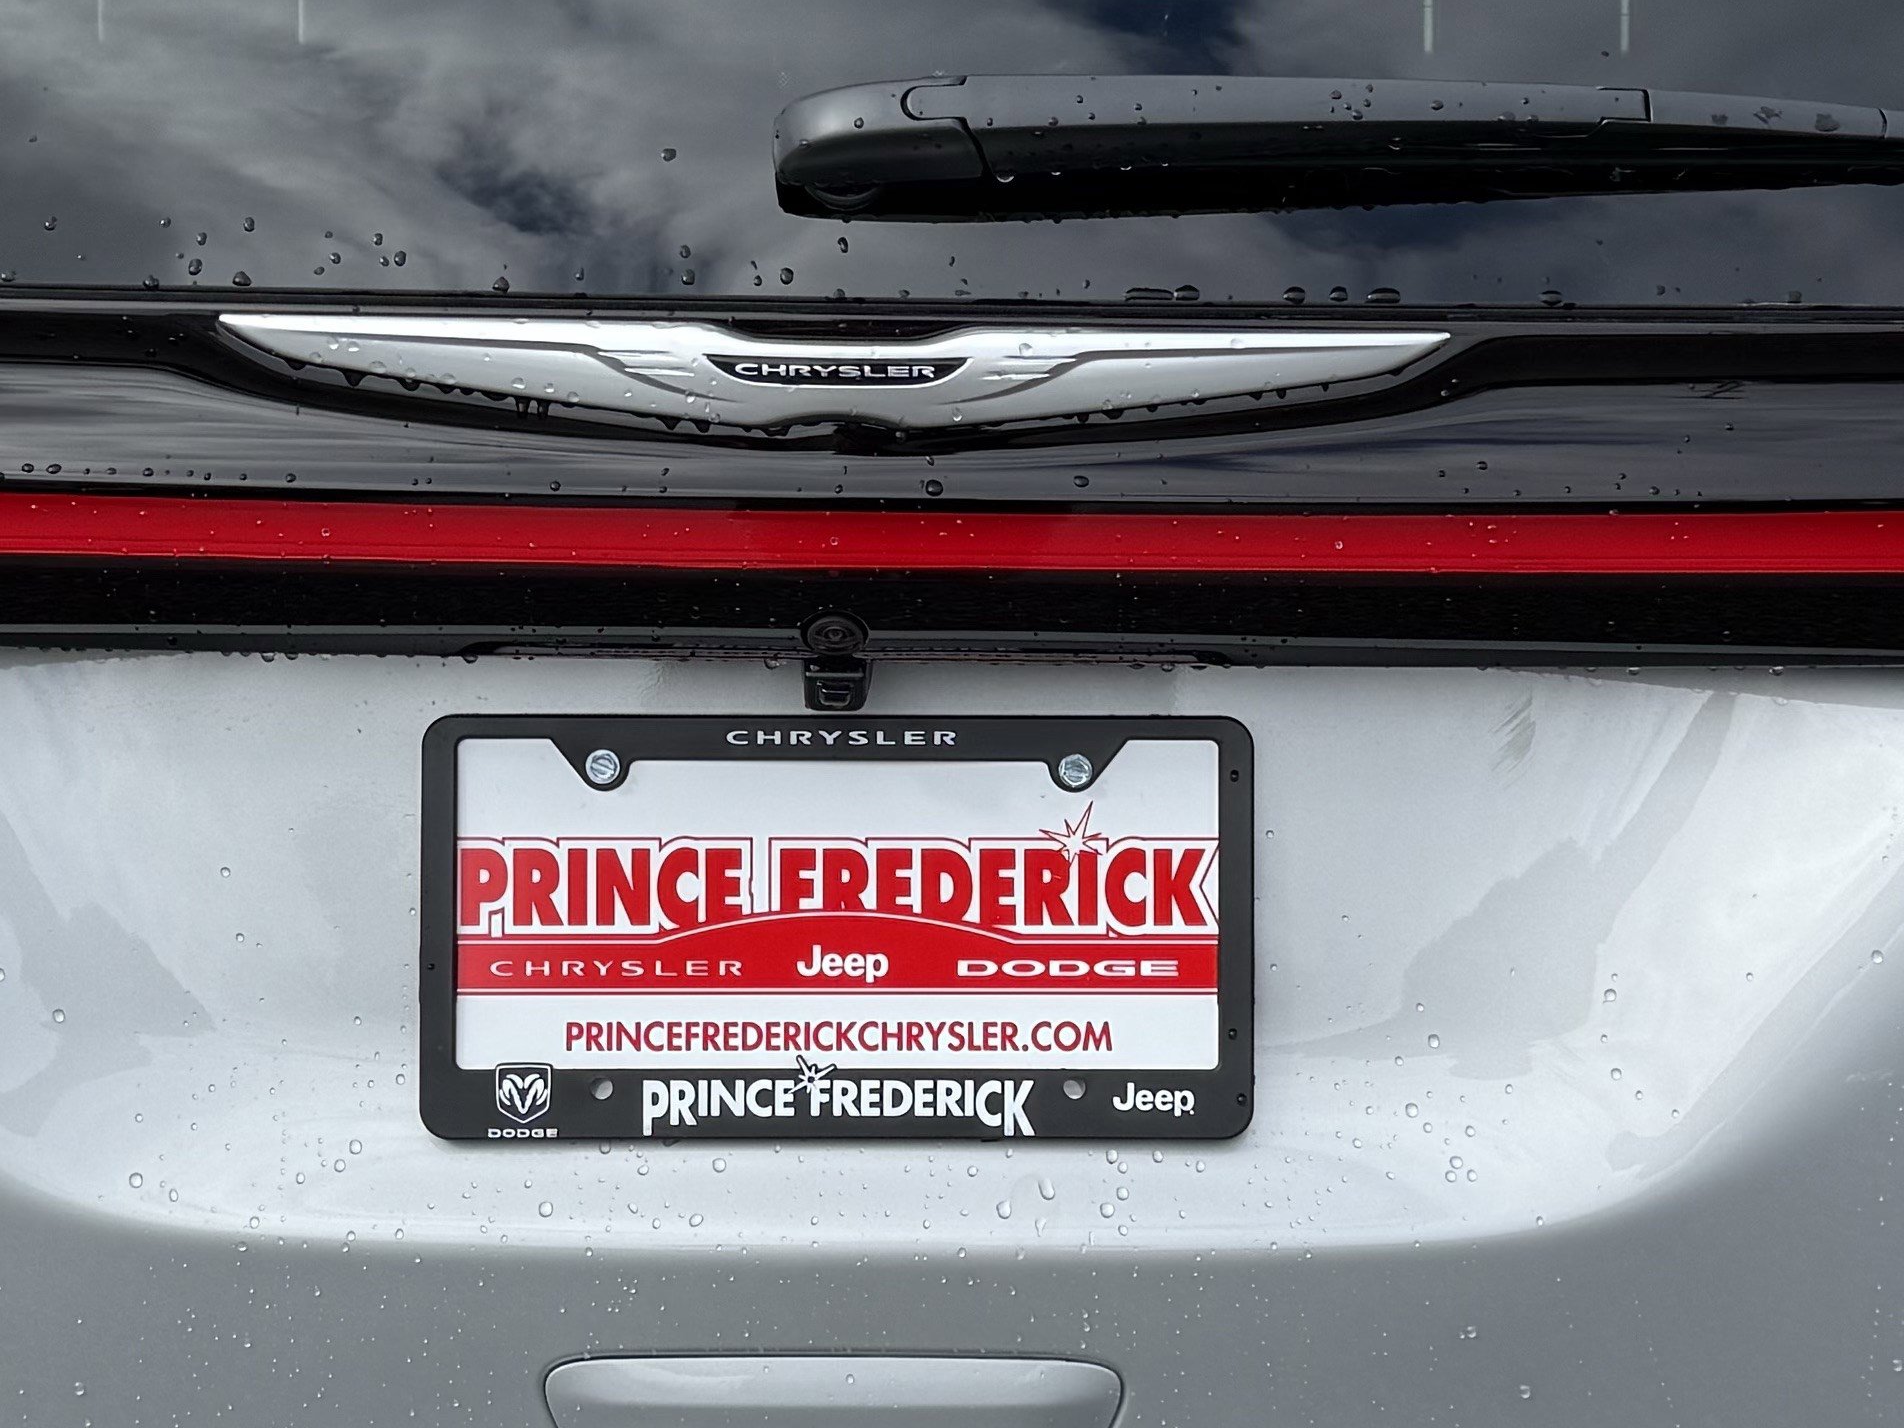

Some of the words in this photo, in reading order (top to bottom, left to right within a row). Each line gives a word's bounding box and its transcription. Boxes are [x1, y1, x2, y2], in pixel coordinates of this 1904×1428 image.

[734, 362, 935, 378] CHRYSLER
[725, 729, 959, 747] CHRYSLER
[458, 846, 752, 928] PRINCE
[778, 846, 1207, 928] FREDERICK
[489, 960, 743, 977] CHRYSLER
[796, 944, 889, 984] Jeep
[956, 959, 1180, 977] DODGE
[565, 1020, 1113, 1052] PRINCEFREDERICKCHRYSLER.COM
[641, 1079, 795, 1136] PRINCE
[809, 1079, 1036, 1137] FREDERICK
[1112, 1083, 1196, 1116] Jeep
[487, 1127, 558, 1138] DODGE
